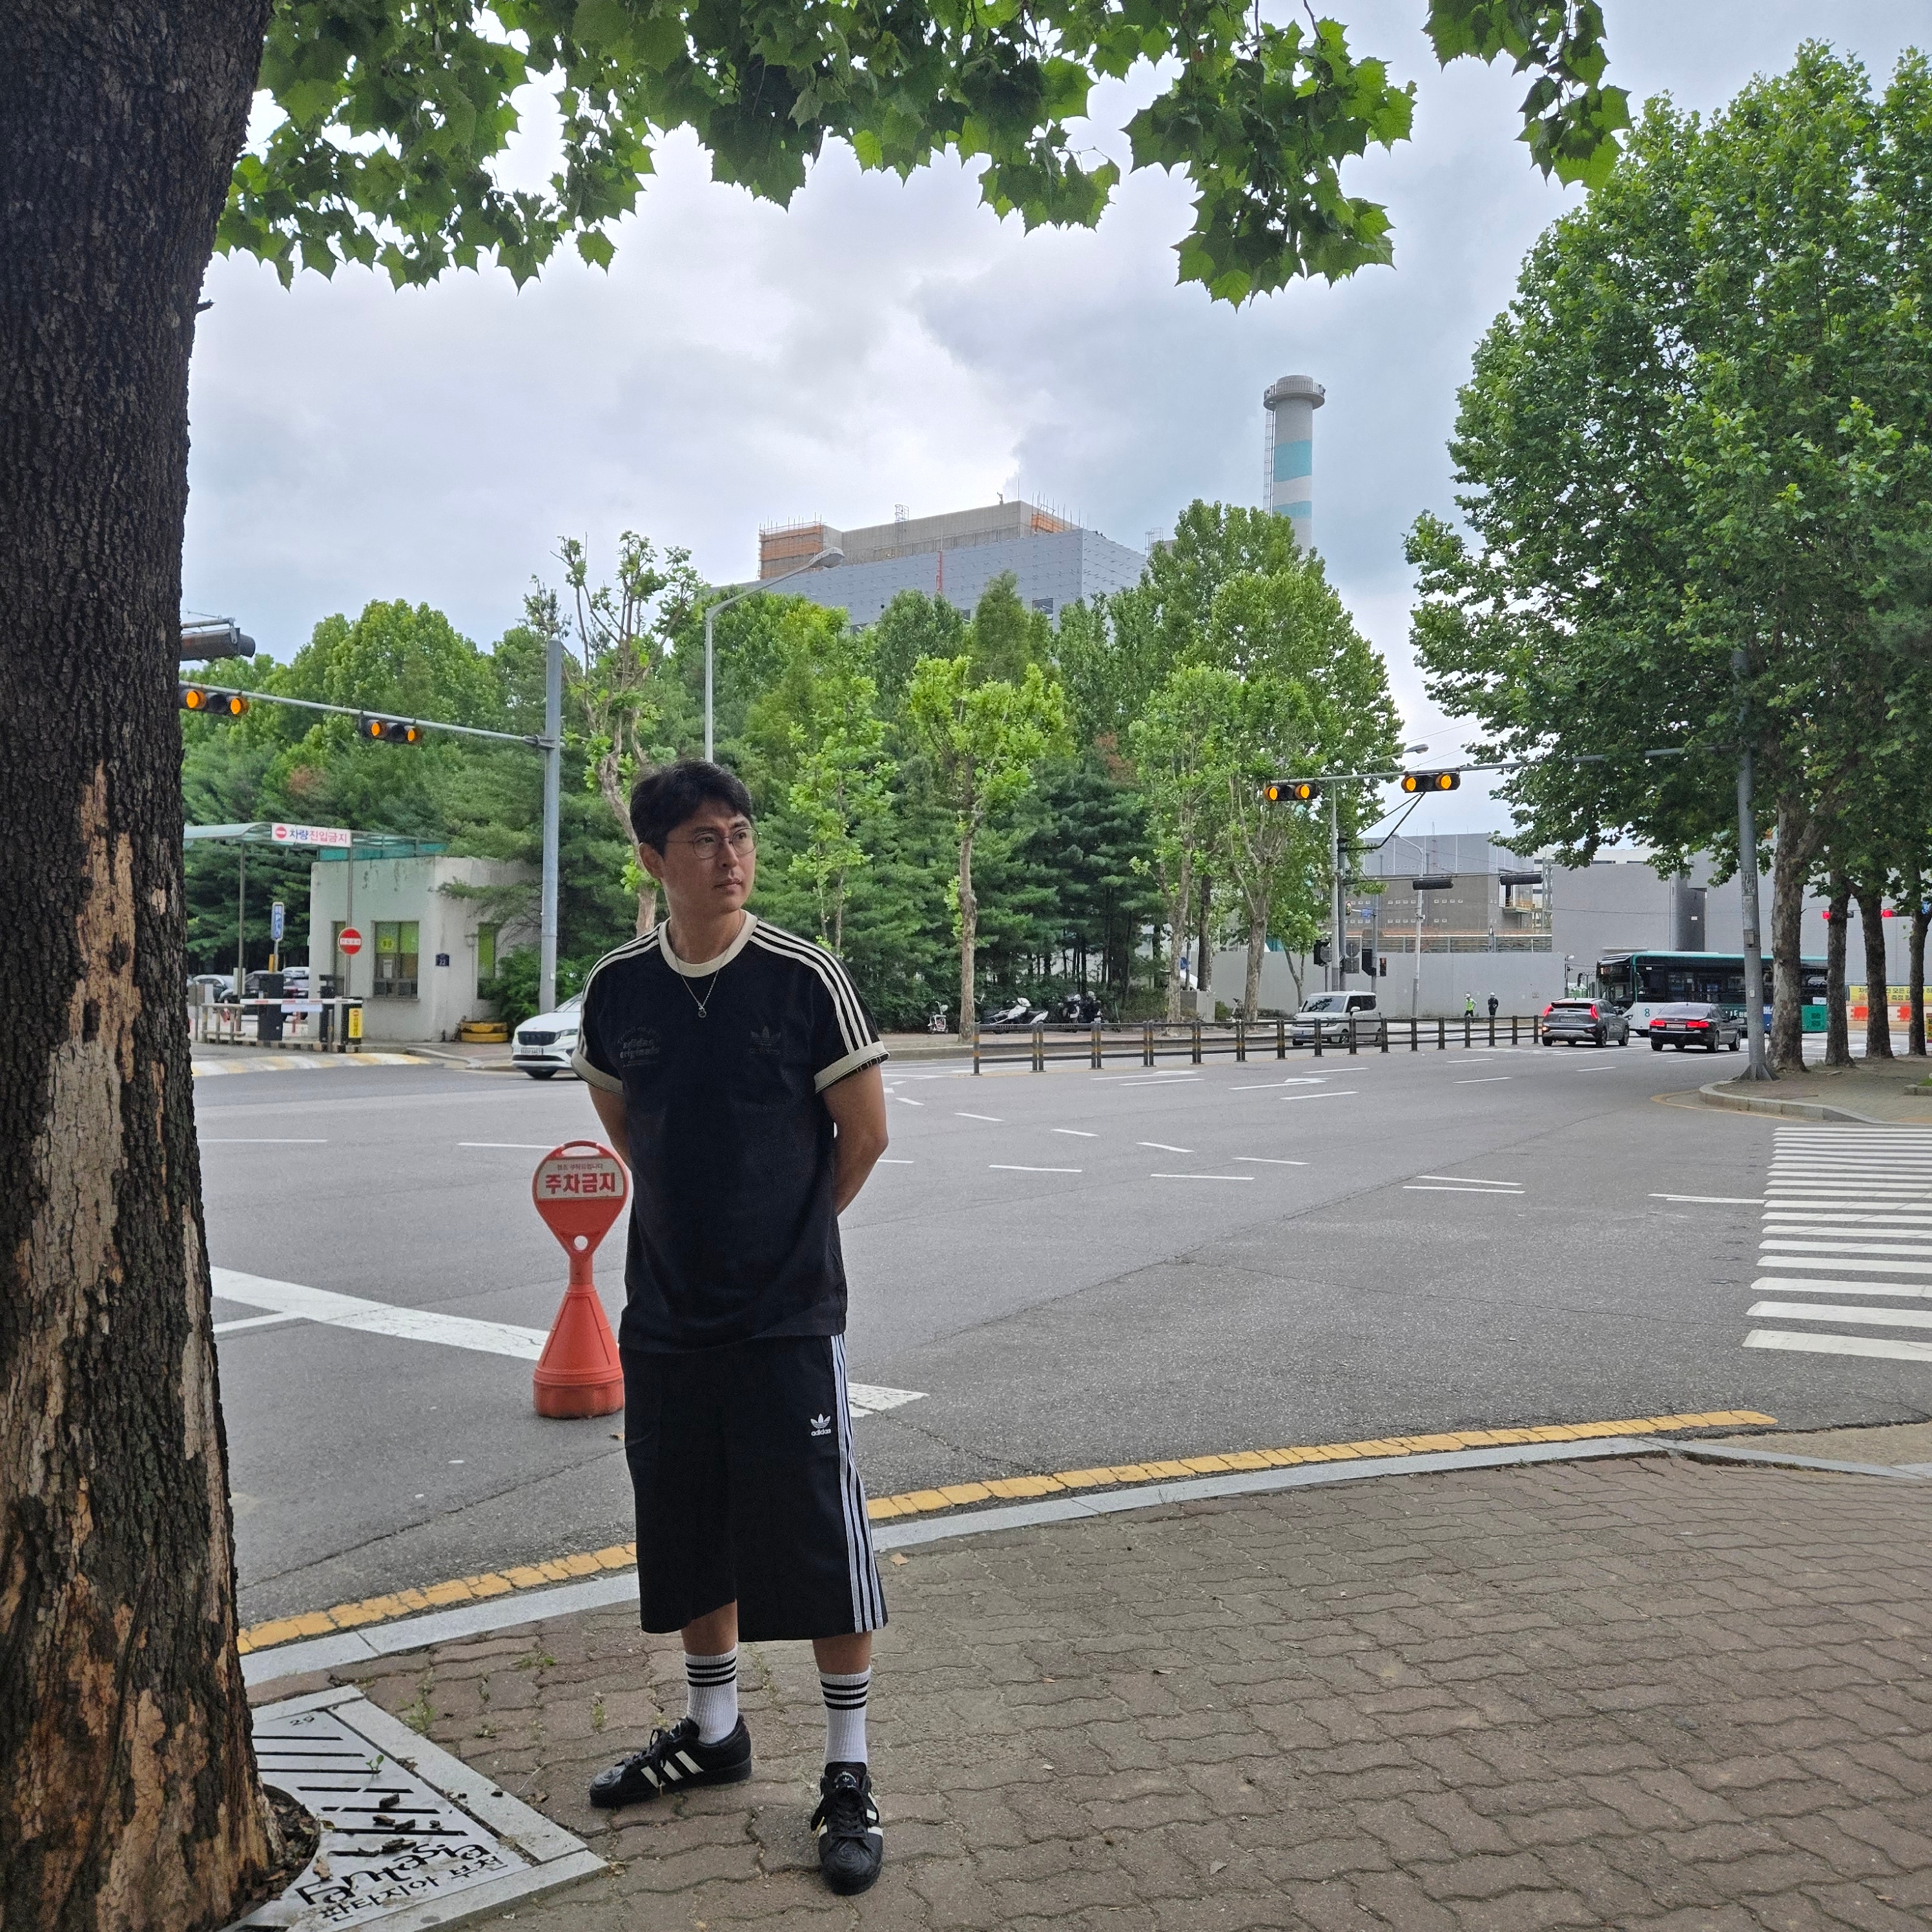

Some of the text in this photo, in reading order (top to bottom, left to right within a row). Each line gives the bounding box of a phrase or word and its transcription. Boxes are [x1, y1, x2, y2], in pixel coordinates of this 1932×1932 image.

[289, 828, 347, 843] 차량진입금지
[1645, 1008, 1650, 1017] 8
[546, 1172, 615, 1195] 주차금지
[811, 1428, 831, 1437] adidas
[295, 1843, 491, 1906] Fantasia
[319, 1855, 508, 1922] 판타지아 부천
